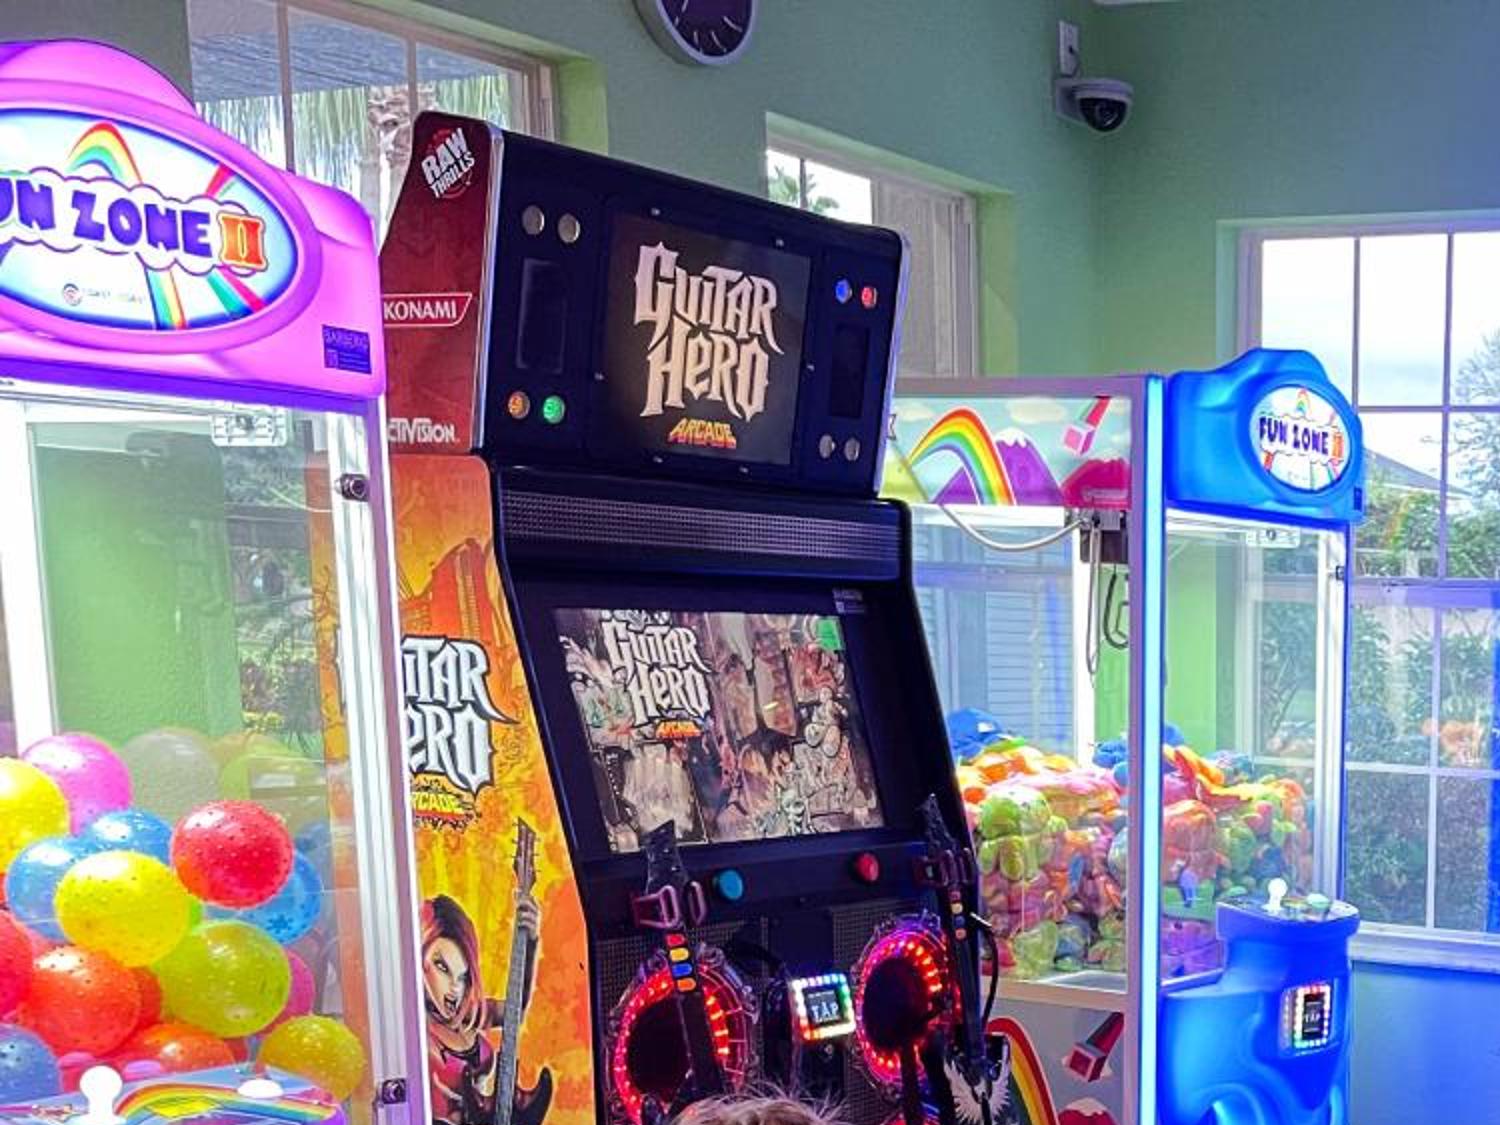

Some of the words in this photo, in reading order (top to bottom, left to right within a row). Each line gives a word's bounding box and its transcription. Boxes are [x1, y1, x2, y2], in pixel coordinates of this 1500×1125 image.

[421, 127, 468, 186] RAW
[71, 190, 213, 259] ZONE
[384, 301, 458, 321] KONAMI
[634, 241, 785, 356] GUITAR
[387, 417, 457, 444] CTIVISION
[667, 417, 737, 449] ARCADE
[1259, 415, 1288, 446] FUN
[1292, 423, 1329, 456] ZONE
[400, 636, 521, 725] ITAR
[601, 618, 713, 690] GUITAR
[406, 701, 495, 797] ERO
